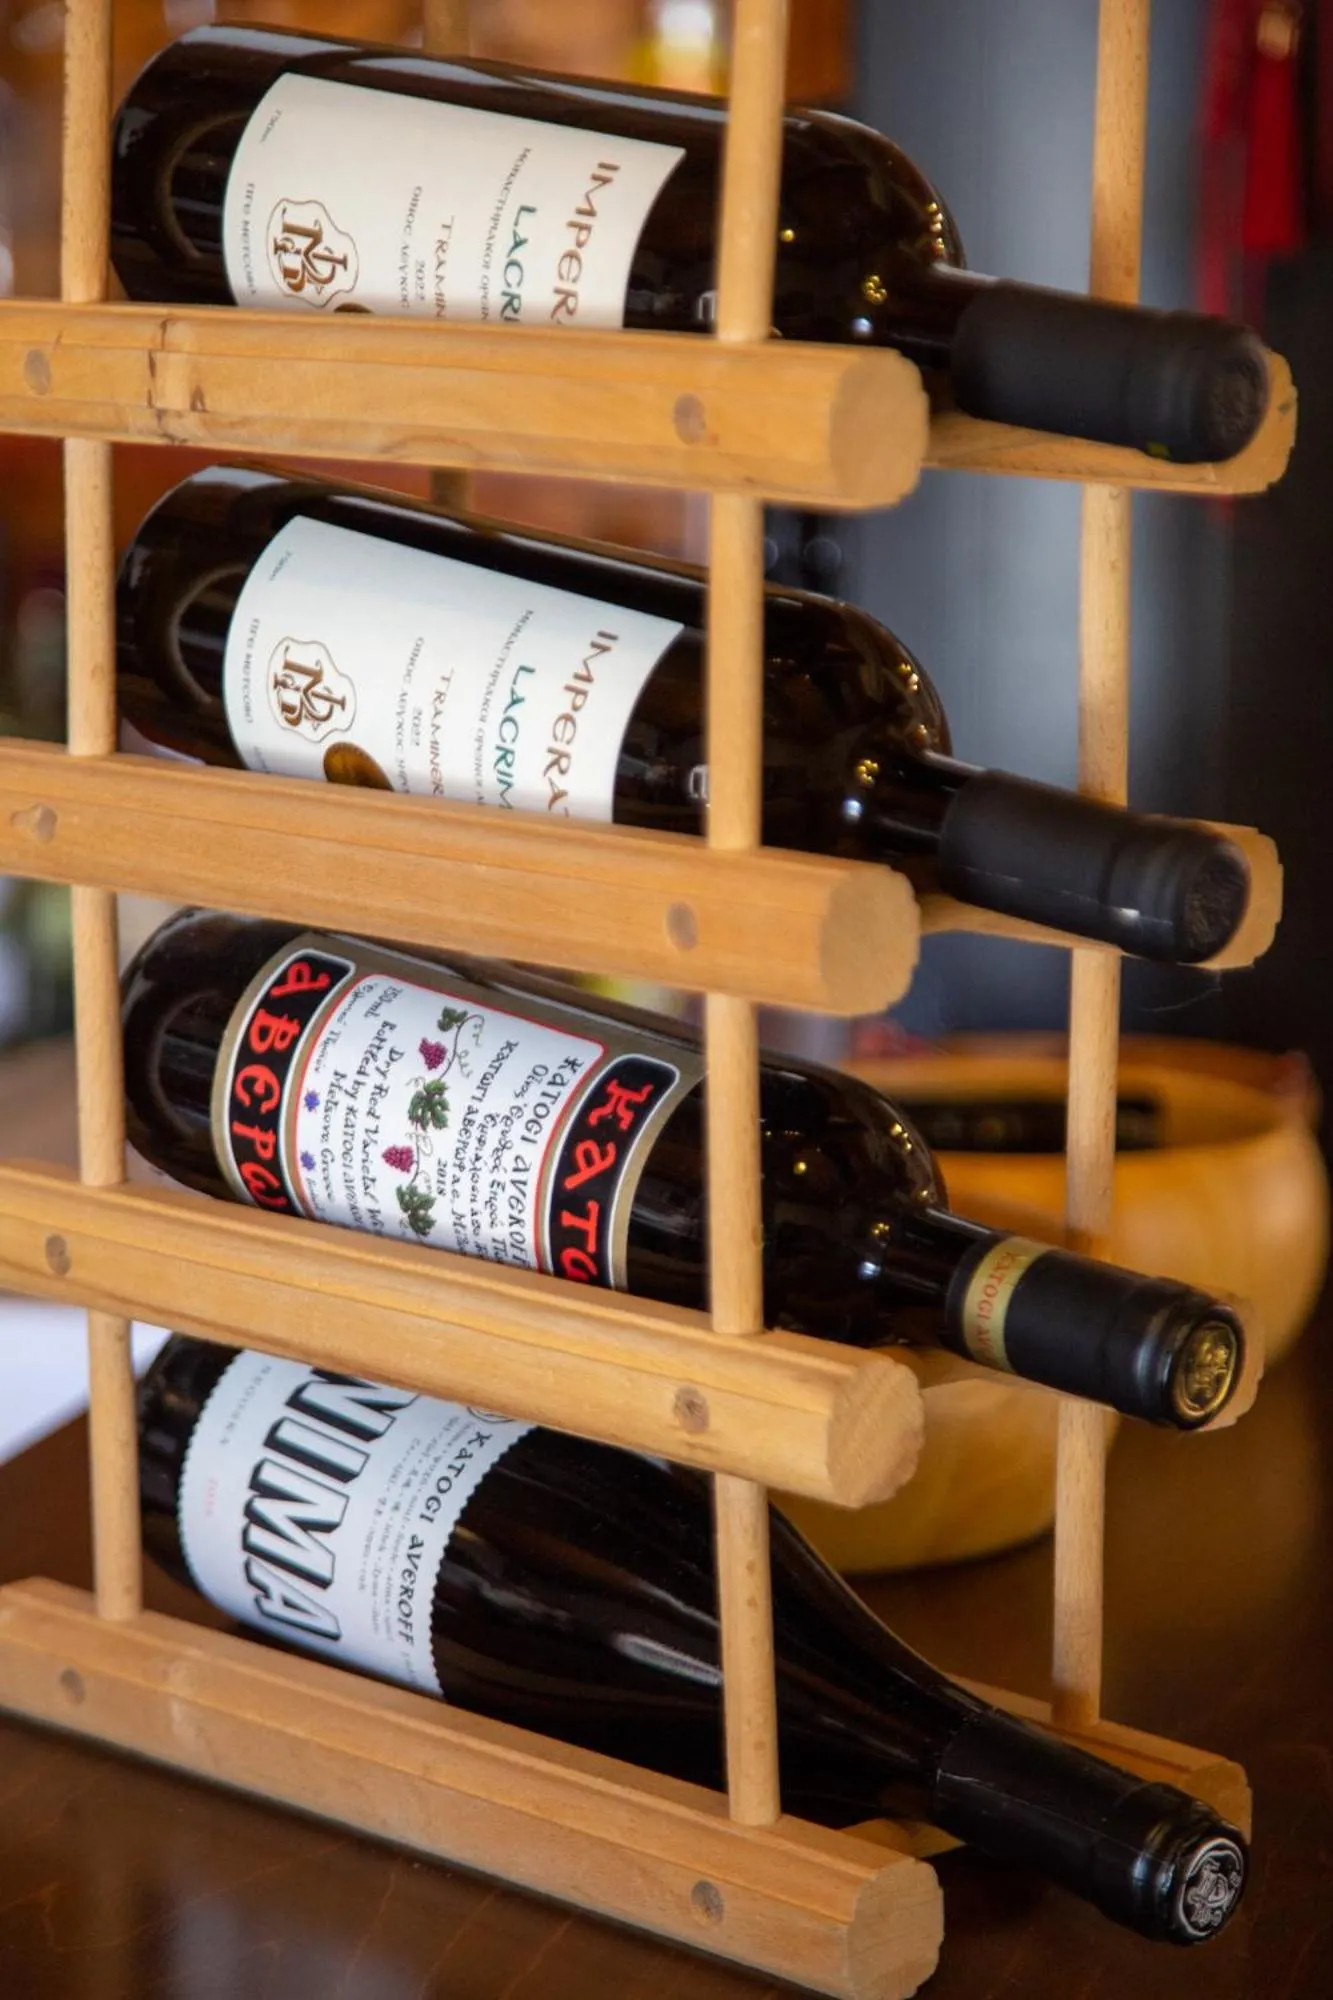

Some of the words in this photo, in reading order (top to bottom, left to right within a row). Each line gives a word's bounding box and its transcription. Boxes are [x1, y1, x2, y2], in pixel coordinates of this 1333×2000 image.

[549, 162, 621, 326] IMPER
[429, 667, 456, 797] TRAMINER
[543, 630, 618, 818] IMPERA
[344, 1079, 366, 1099] by
[356, 1020, 398, 1077] Bottled
[375, 1046, 405, 1080] Dry
[366, 1083, 390, 1120] Red
[520, 1056, 584, 1145] KATOGI
[361, 1124, 380, 1203] Varietal
[437, 1157, 447, 1197] 2018
[418, 1430, 493, 1526] KATOGI
[395, 1533, 426, 1648] AVEROFF
